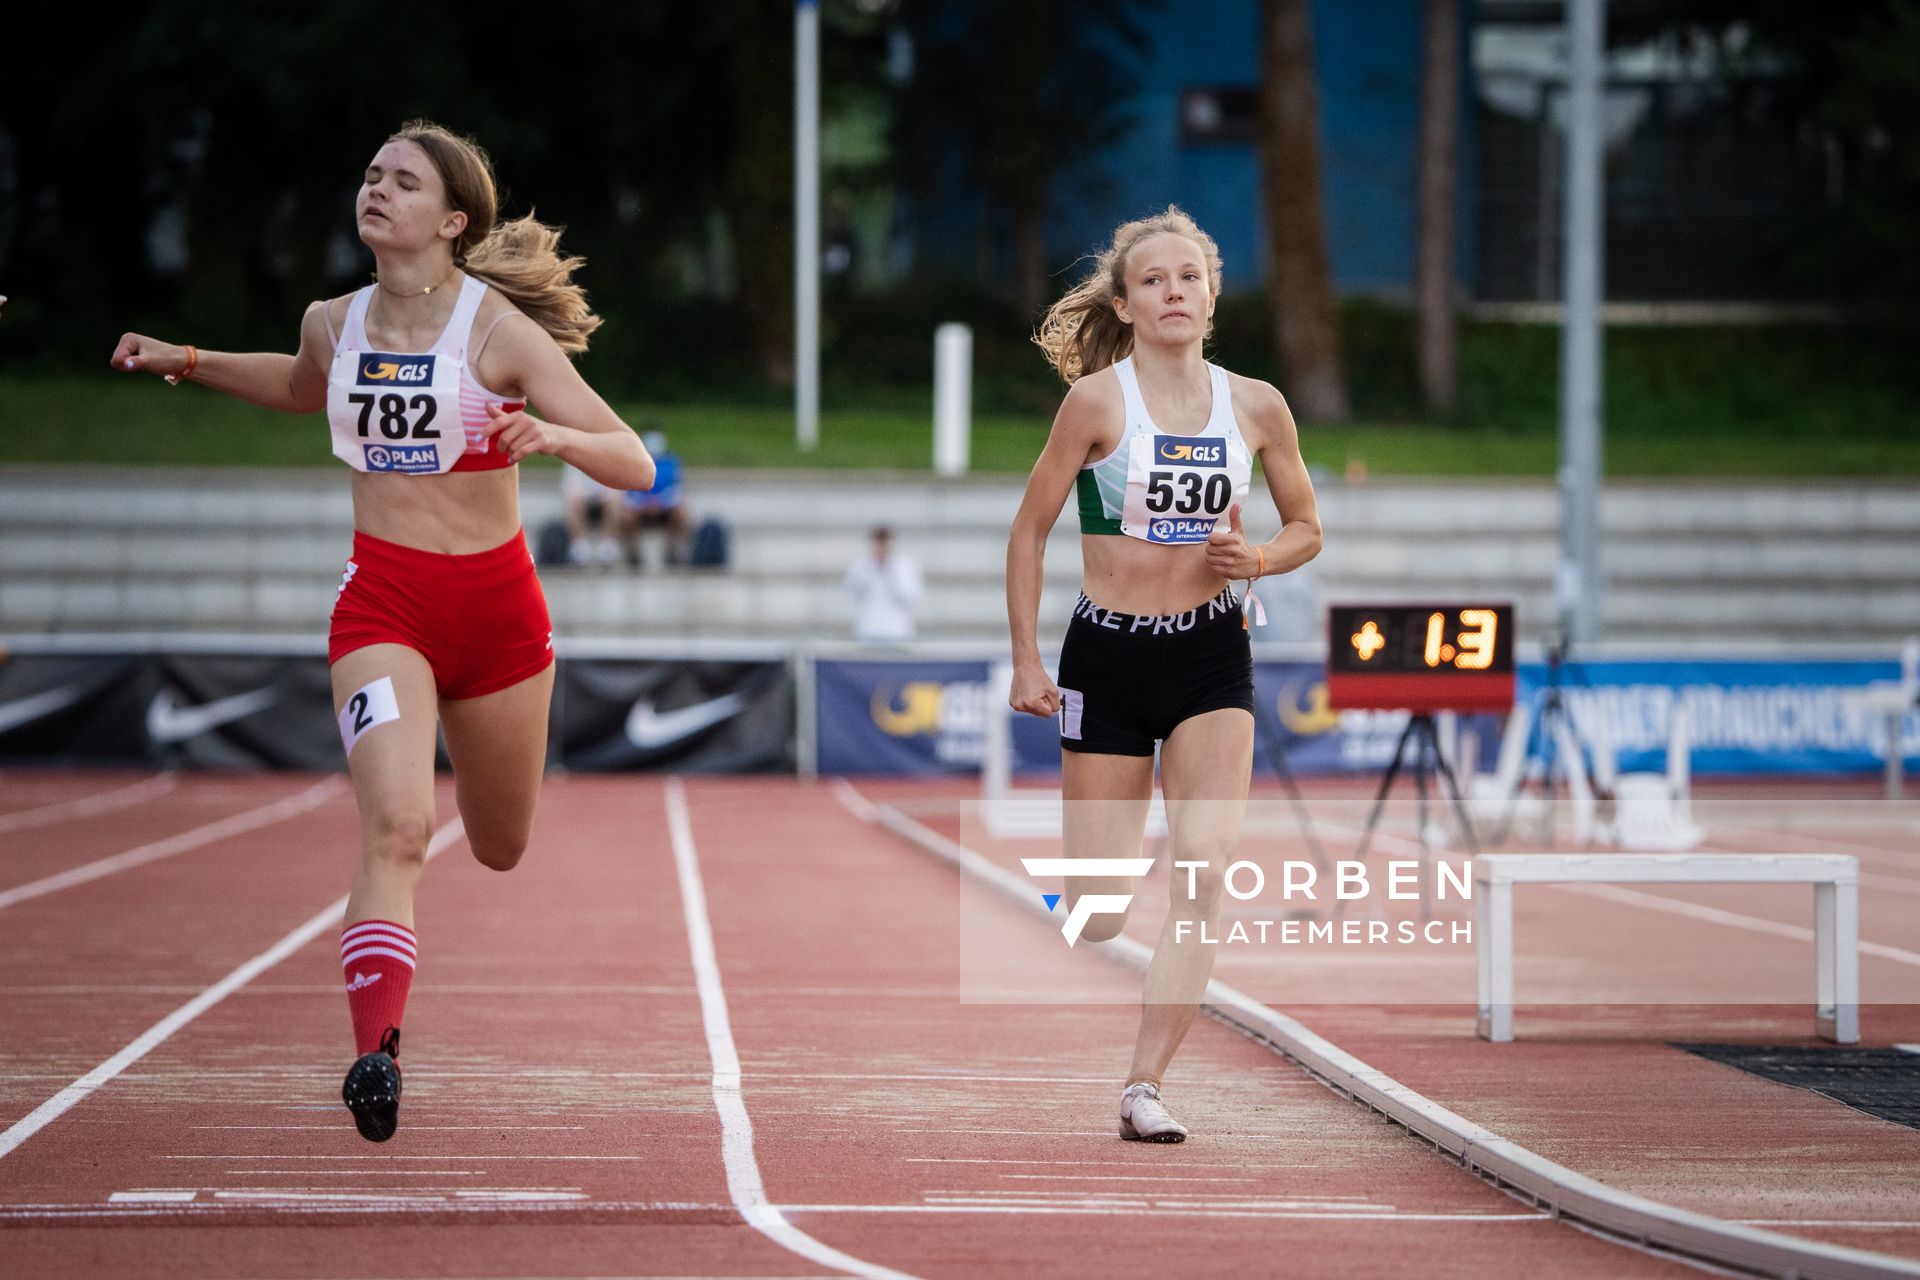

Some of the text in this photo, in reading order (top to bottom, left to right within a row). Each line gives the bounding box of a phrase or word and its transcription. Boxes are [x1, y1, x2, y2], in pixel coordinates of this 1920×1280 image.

[398, 363, 429, 382] GLS
[348, 392, 441, 440] 782
[392, 449, 435, 465] PLAN
[1192, 446, 1220, 462] GLS
[1145, 471, 1232, 515] 530
[1176, 521, 1213, 533] PLAN
[1130, 610, 1197, 635] PRO
[1424, 610, 1497, 669] 1.3
[349, 691, 374, 735] 2
[1060, 694, 1066, 734] 1
